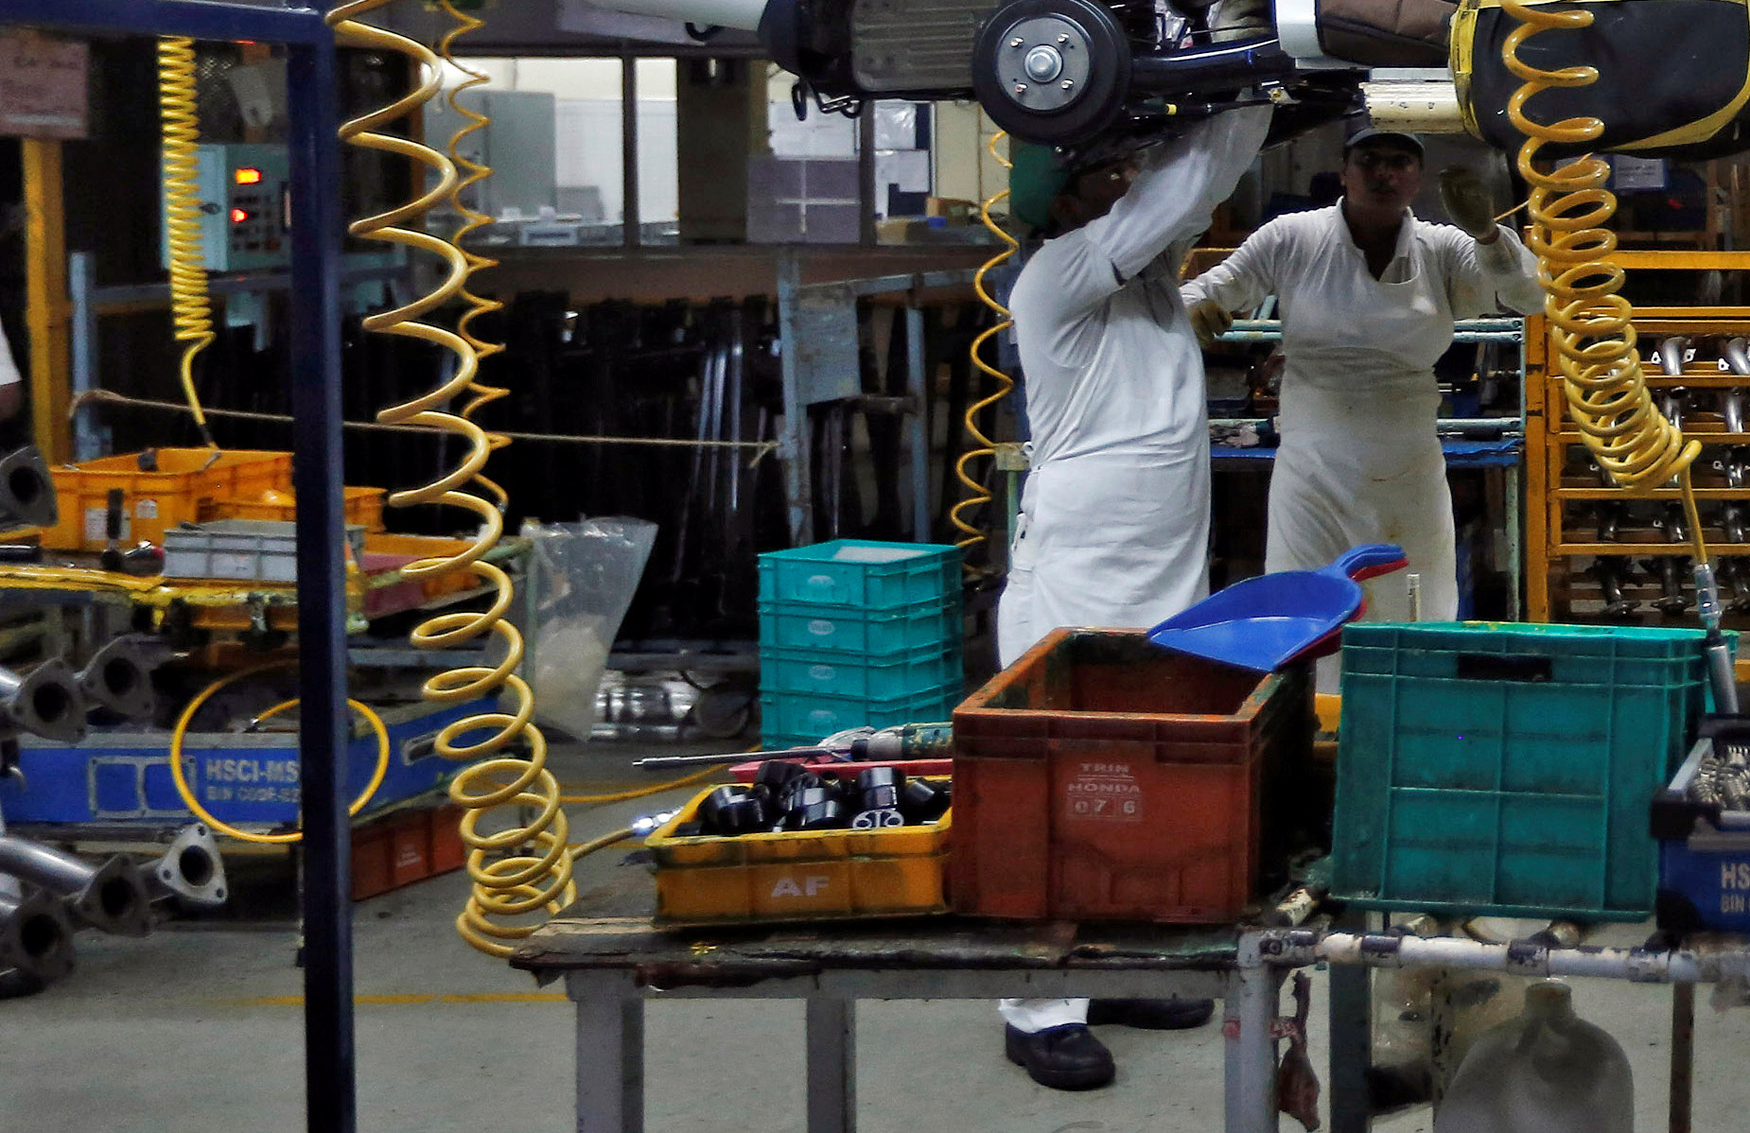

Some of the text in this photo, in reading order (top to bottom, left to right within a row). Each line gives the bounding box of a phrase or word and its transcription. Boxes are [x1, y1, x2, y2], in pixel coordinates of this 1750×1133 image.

[206, 759, 300, 782] HSCI-MS
[1067, 782, 1140, 793] HONDA
[771, 875, 831, 898] AF
[1721, 895, 1746, 914] BIN
